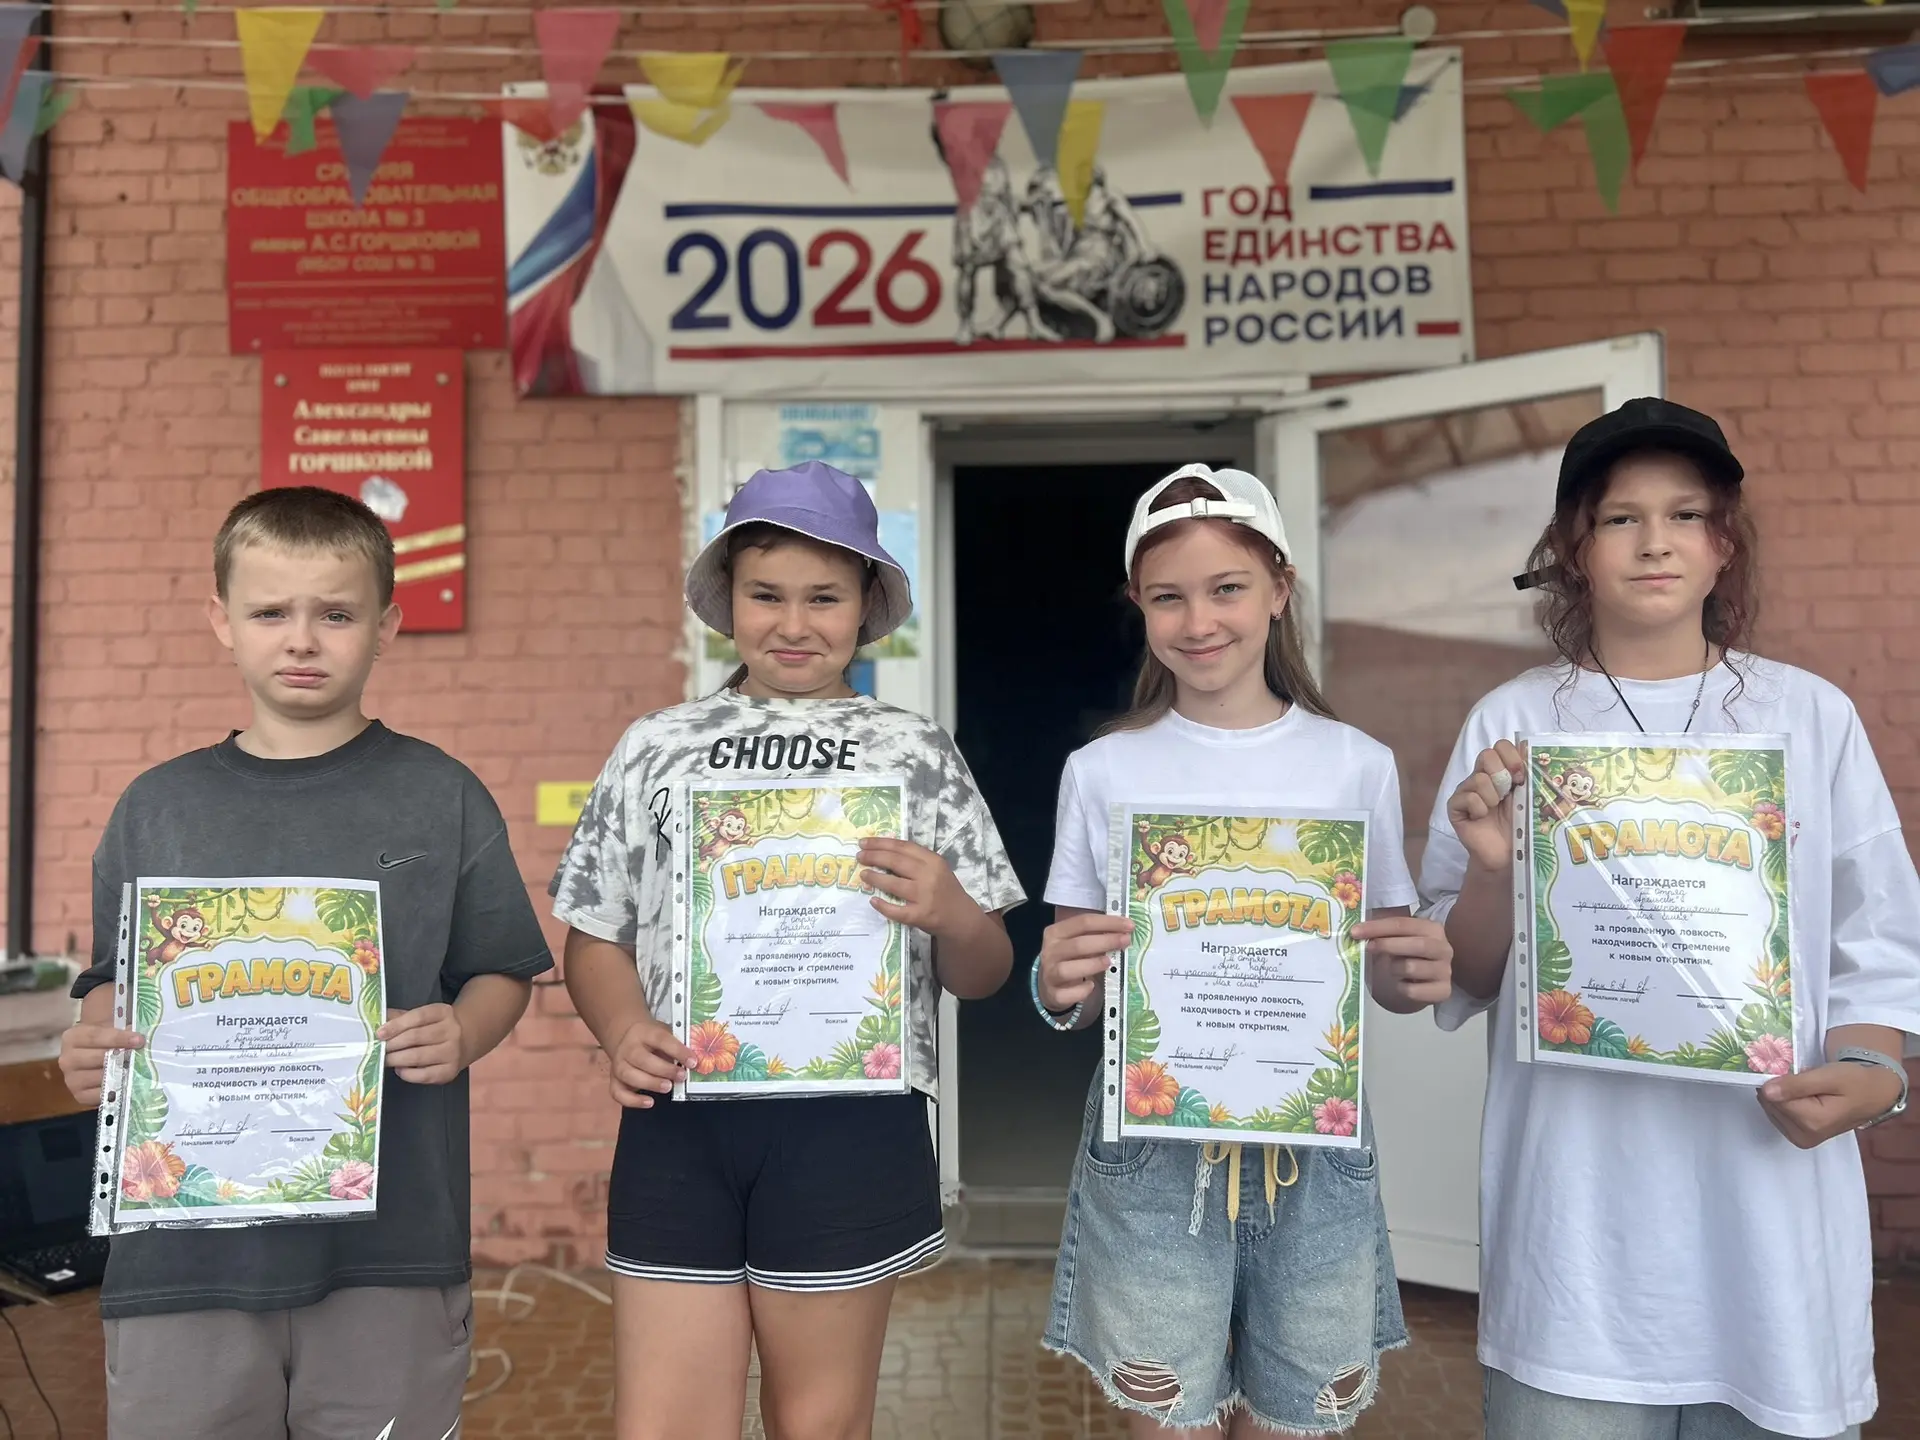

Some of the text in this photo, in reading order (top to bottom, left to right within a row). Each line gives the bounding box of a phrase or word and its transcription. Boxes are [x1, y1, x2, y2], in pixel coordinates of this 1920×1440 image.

[316, 162, 415, 181] СРНЯЯ
[232, 184, 498, 207] ОБЩЕОБРАОВАТЕЛЬНАЯ
[1202, 186, 1293, 222] ГОД
[1204, 222, 1456, 267] ЕДИНСТВА
[666, 227, 943, 330] 2026
[1204, 265, 1432, 305] НАРОДОВ
[1204, 306, 1404, 346] РОССИИ
[708, 734, 860, 771] CHOOSE
[1565, 818, 1753, 871] ГРАМОТА
[1612, 874, 1706, 889] Награждается
[759, 905, 836, 918] Награждается
[1160, 887, 1331, 939] ГРАМОТА
[1609, 925, 1675, 937] проявленную
[1680, 929, 1727, 939] ловкость,
[1201, 942, 1288, 957] Награждается
[1592, 937, 1657, 949] находчивость
[1672, 942, 1730, 953] стремление
[756, 952, 810, 961] проявленную
[813, 952, 851, 960] ловкость,
[1619, 953, 1651, 962] новым
[1656, 955, 1712, 966] открытиям.
[741, 966, 795, 975] находчивость
[807, 964, 854, 973] стремление
[172, 957, 353, 1008] ГРАМОТА
[793, 977, 839, 986] открытиям.
[1197, 993, 1258, 1004] проявленную
[1261, 996, 1304, 1006] ловкость,
[1181, 1006, 1241, 1017] находчивость
[1254, 1009, 1306, 1019] стремление
[217, 1015, 308, 1028] Награждается
[1239, 1023, 1289, 1032] открытиям.
[196, 1064, 324, 1075] за проявленную ловкость,
[192, 1079, 258, 1089] находчивость
[271, 1078, 326, 1087] стремление
[254, 1093, 308, 1102] открытиям.
